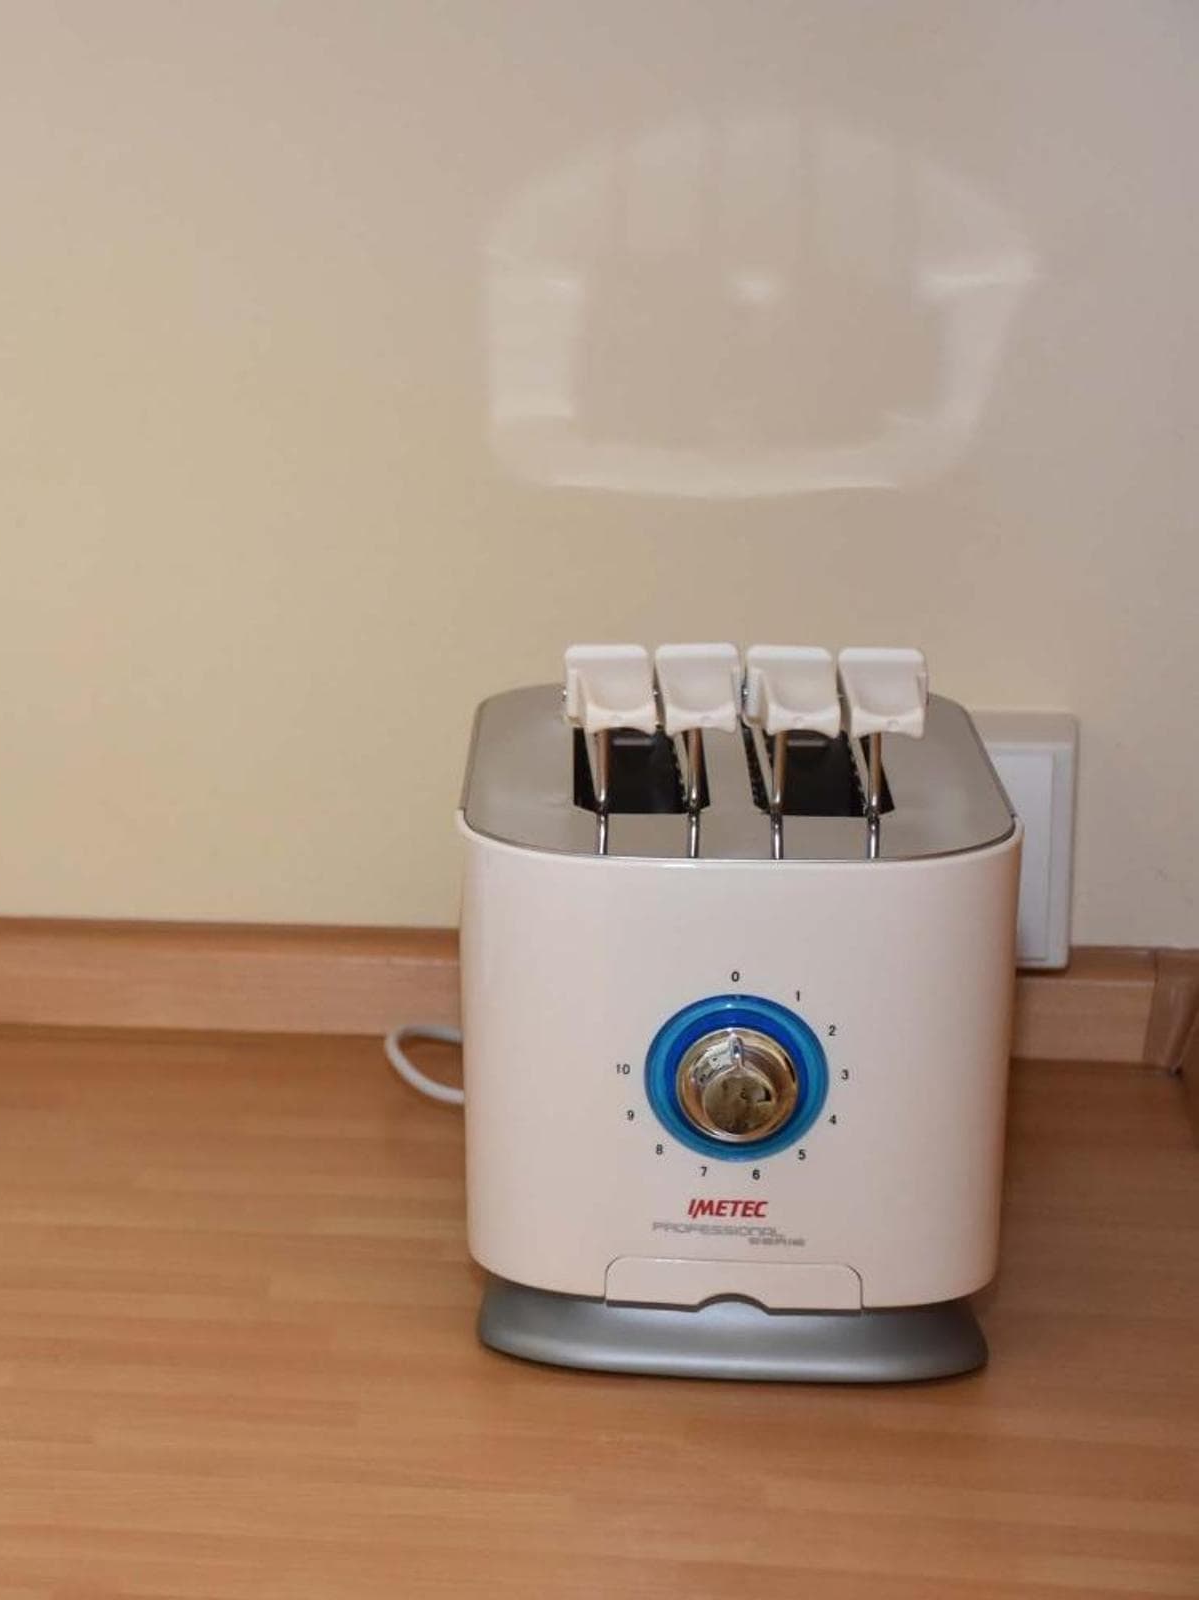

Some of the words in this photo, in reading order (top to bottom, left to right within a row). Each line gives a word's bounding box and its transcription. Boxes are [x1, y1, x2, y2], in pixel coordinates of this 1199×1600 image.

[731, 971, 741, 983] 0
[795, 990, 801, 1002] 1
[828, 1025, 837, 1037] 2
[615, 1063, 631, 1075] 10
[841, 1069, 849, 1081] 3
[626, 1110, 635, 1122] 9
[829, 1114, 837, 1125] 4
[655, 1144, 664, 1156] 8
[798, 1149, 807, 1161] 5
[700, 1166, 708, 1178] 7
[752, 1169, 761, 1181] 6
[687, 1198, 769, 1219] IMETEC
[652, 1221, 778, 1238] PROFESSIONAL
